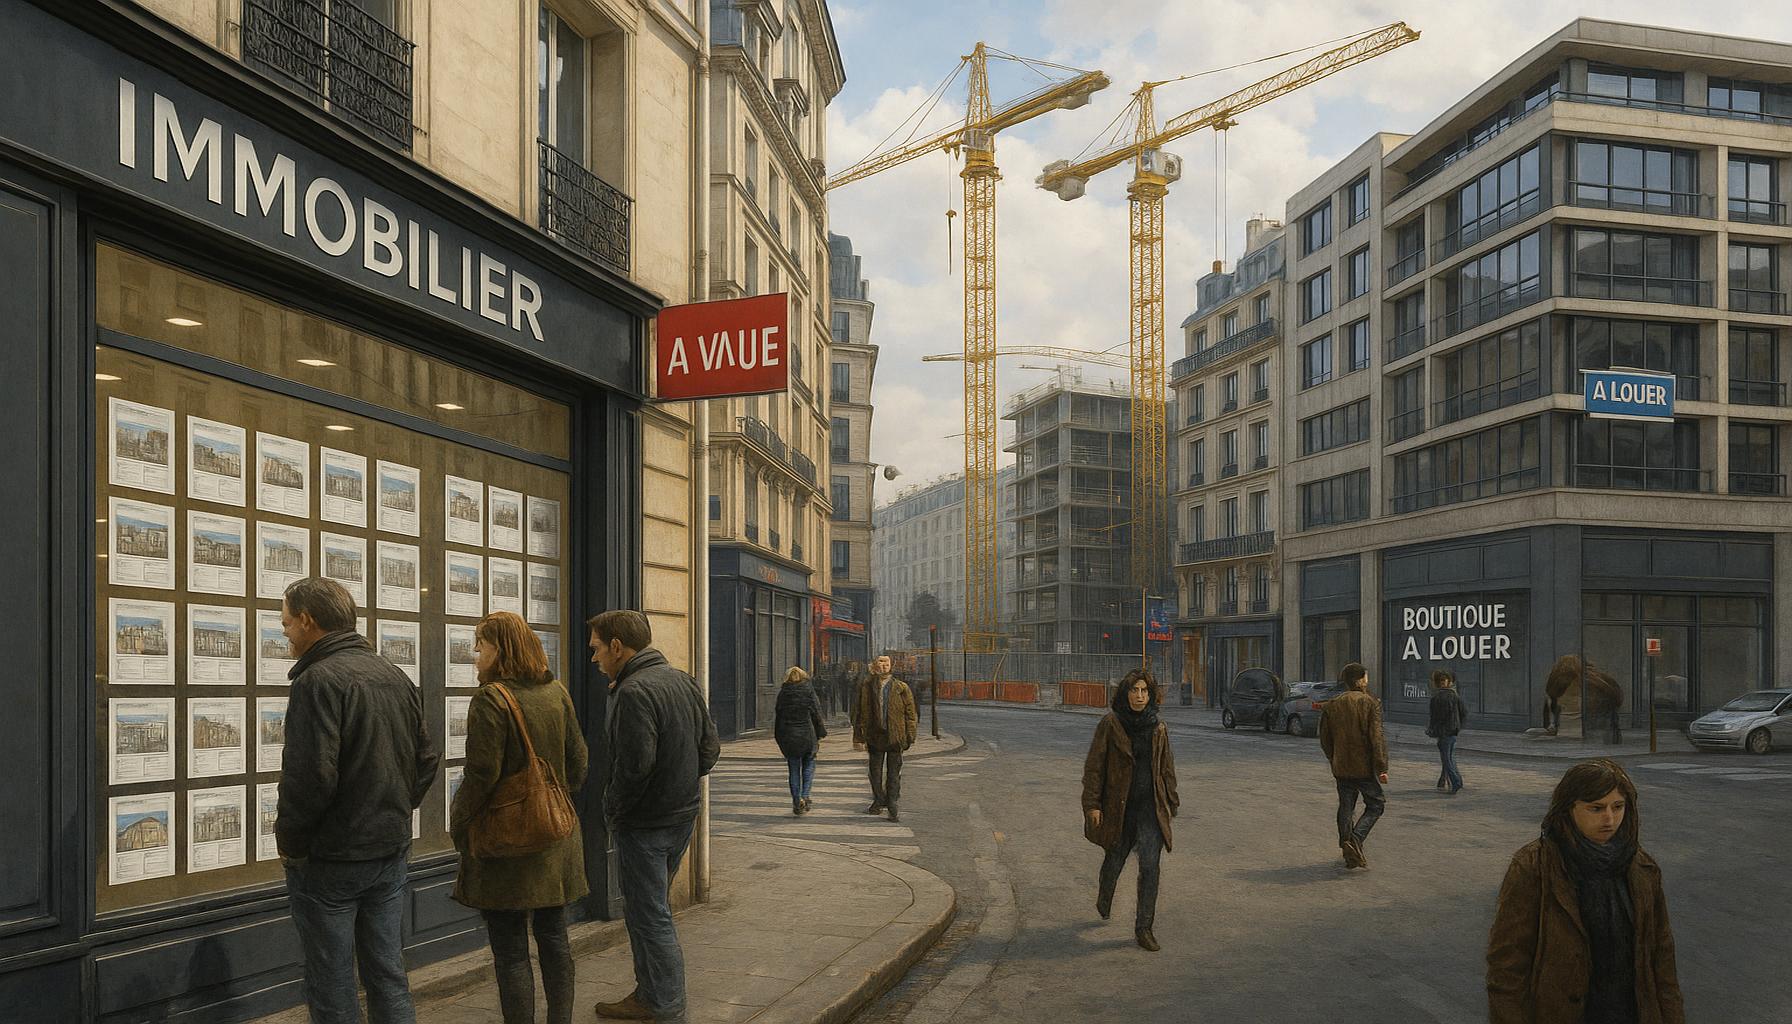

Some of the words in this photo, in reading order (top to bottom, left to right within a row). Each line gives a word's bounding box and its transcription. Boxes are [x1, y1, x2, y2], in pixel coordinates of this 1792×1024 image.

[118, 77, 544, 342] IMMOBILIER
[667, 336, 689, 376] A
[1592, 380, 1607, 401] A
[1610, 381, 1667, 406] LOUER
[1402, 635, 1422, 660] A
[1429, 634, 1511, 660] LOUER
